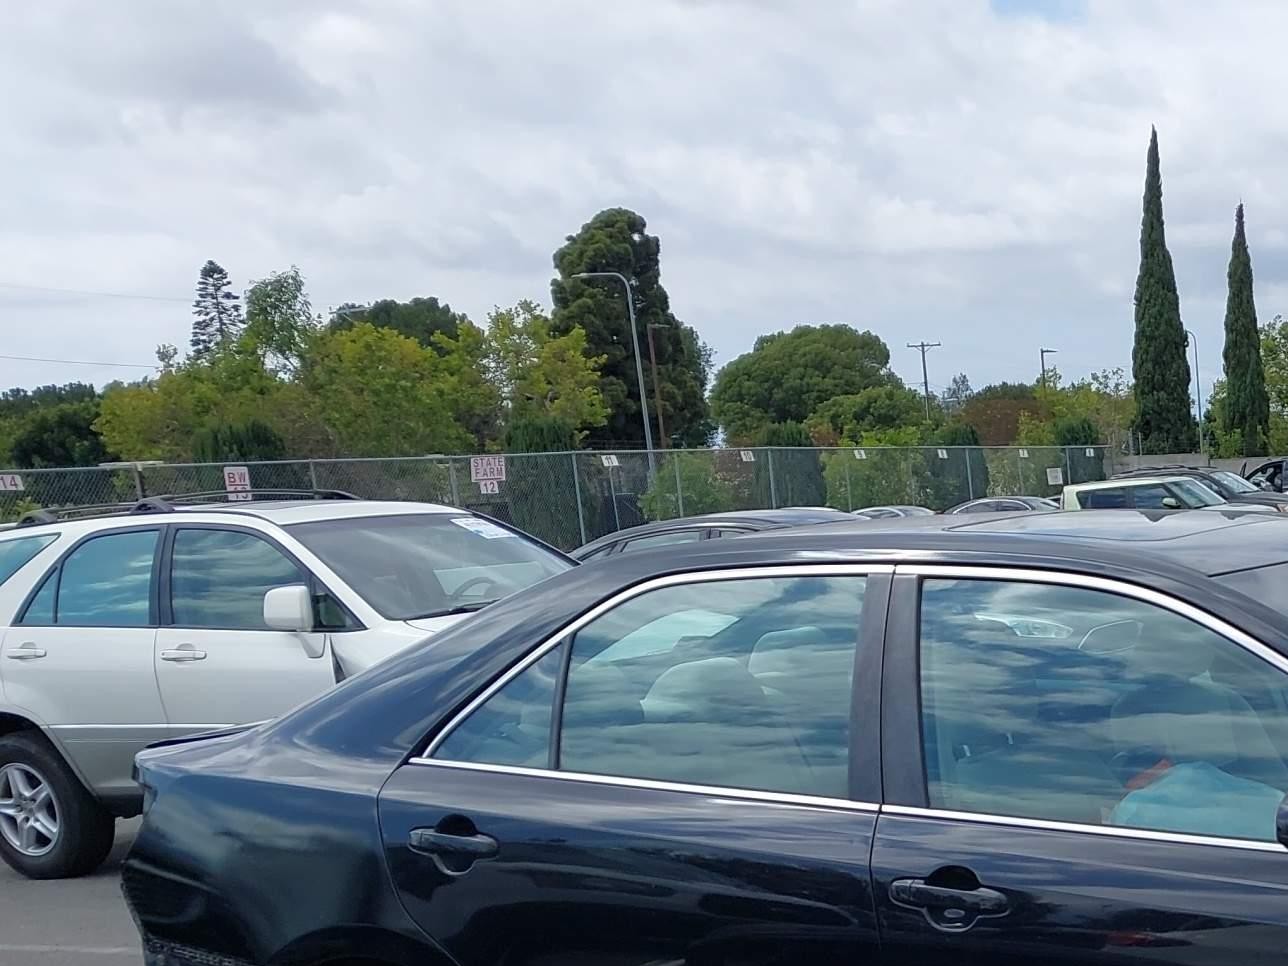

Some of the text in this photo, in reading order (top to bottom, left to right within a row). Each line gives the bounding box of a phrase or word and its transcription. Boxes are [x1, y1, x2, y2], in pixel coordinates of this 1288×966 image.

[473, 457, 504, 468] STATE
[226, 471, 247, 484] BW
[474, 467, 503, 477] FARM
[0, 475, 18, 489] 14
[483, 481, 498, 493] 12
